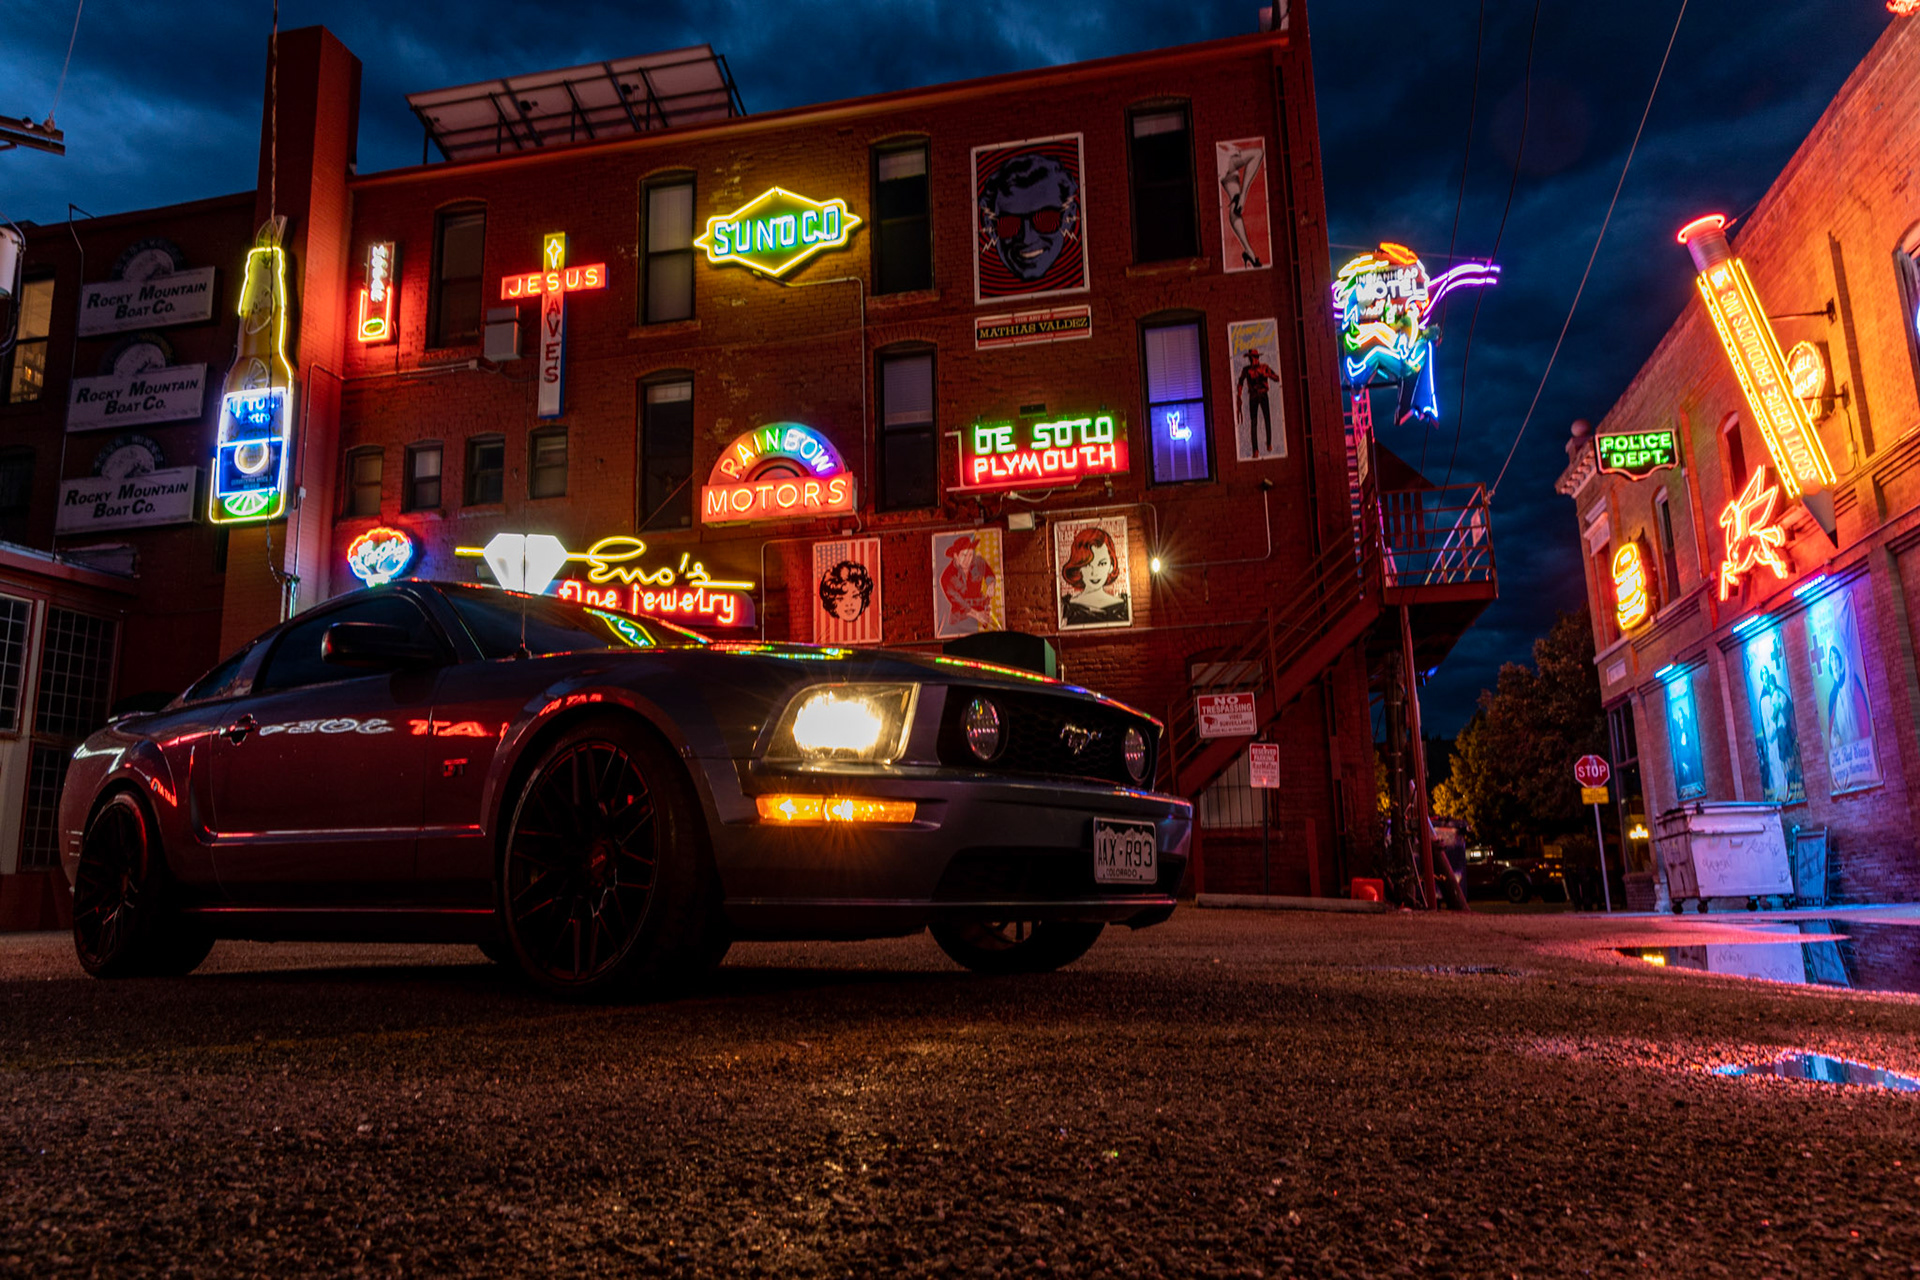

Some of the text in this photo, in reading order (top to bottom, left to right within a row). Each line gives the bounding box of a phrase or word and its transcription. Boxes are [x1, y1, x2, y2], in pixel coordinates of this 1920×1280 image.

[714, 205, 842, 256] SUNOCO
[508, 268, 599, 297] JESUS
[978, 323, 1037, 339] MATHIAS
[1039, 317, 1089, 333] VALDEZ
[974, 416, 1113, 455] DE SOTO
[1600, 432, 1672, 453] POLICE
[720, 428, 836, 480] RAINBOW
[974, 443, 1116, 483] PLYMOUTH
[707, 479, 847, 515] MOTORS
[586, 535, 735, 588] Eno's
[1201, 703, 1252, 715] TRESPASSING
[1214, 696, 1239, 706] NO
[1577, 764, 1607, 778] STOP
[1105, 867, 1138, 878] COLORADO
